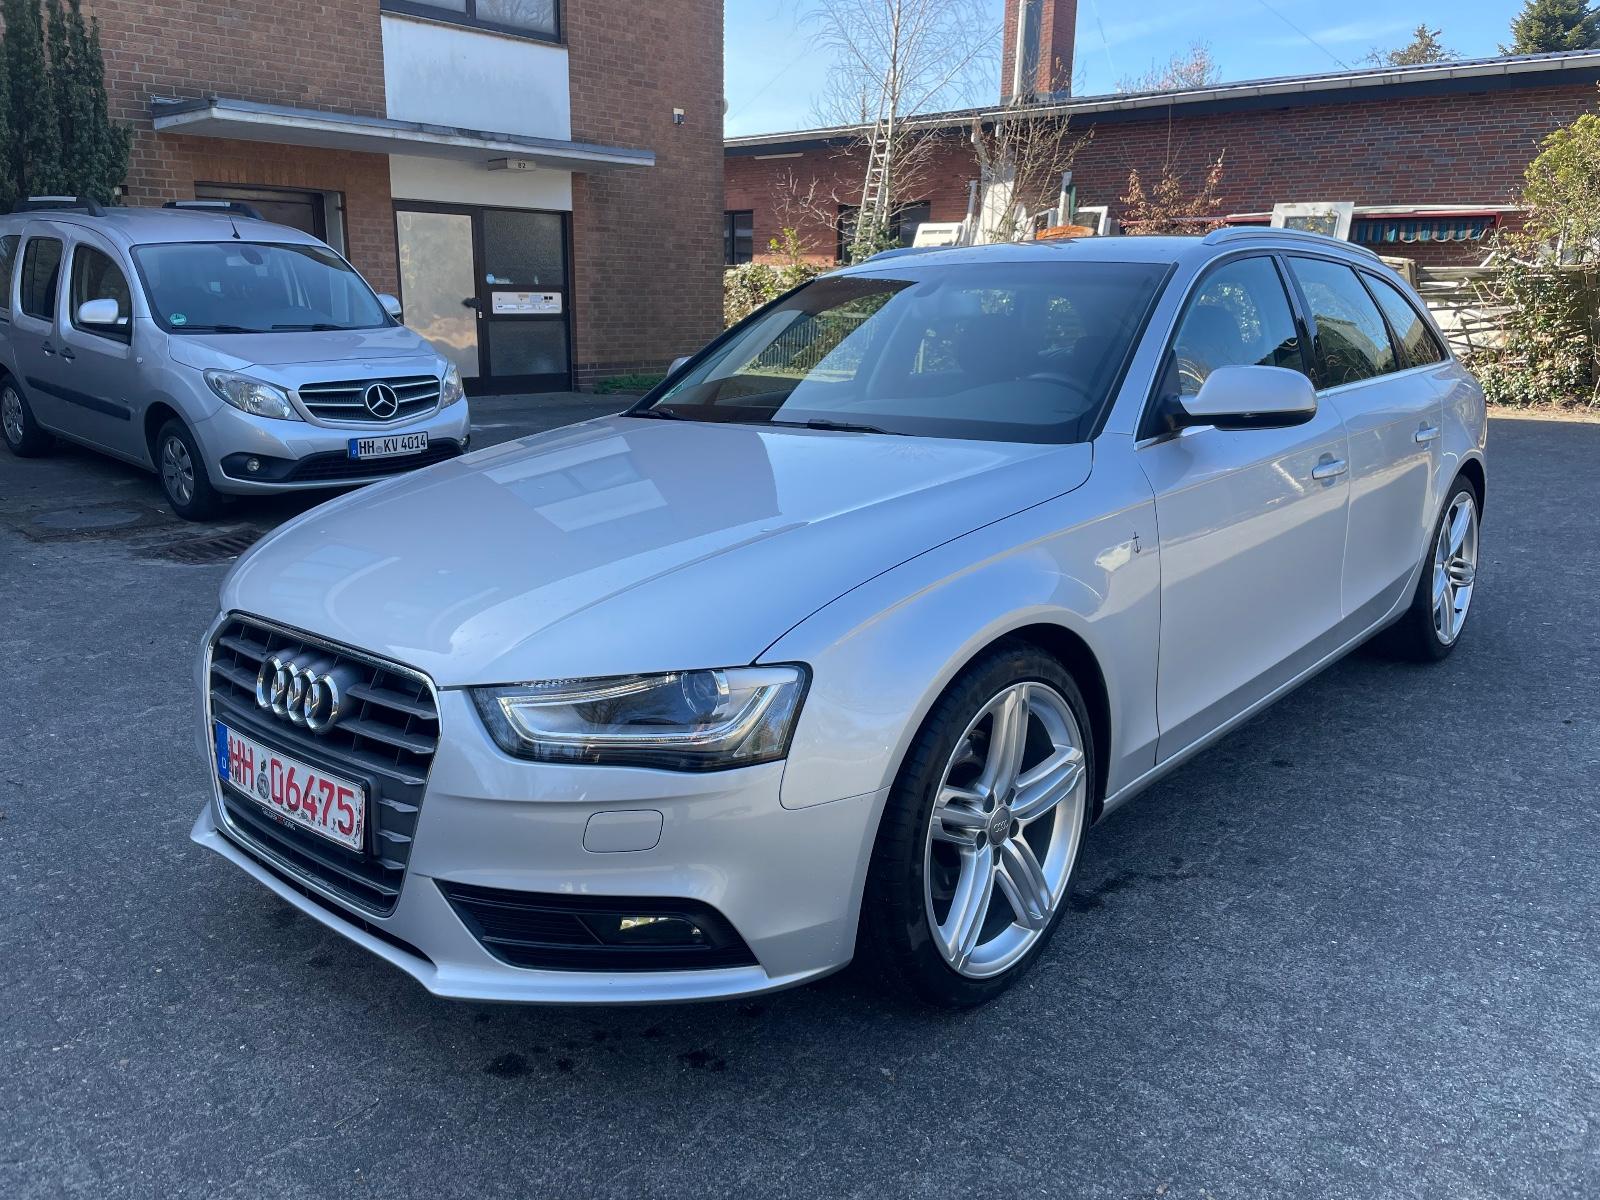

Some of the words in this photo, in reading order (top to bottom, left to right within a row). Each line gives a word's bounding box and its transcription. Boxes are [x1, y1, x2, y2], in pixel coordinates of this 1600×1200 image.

[359, 440, 375, 455] HH
[383, 438, 398, 452] KV
[401, 434, 426, 450] 4014
[221, 756, 227, 769] D
[229, 735, 254, 791] HH
[271, 757, 354, 836] 06475
